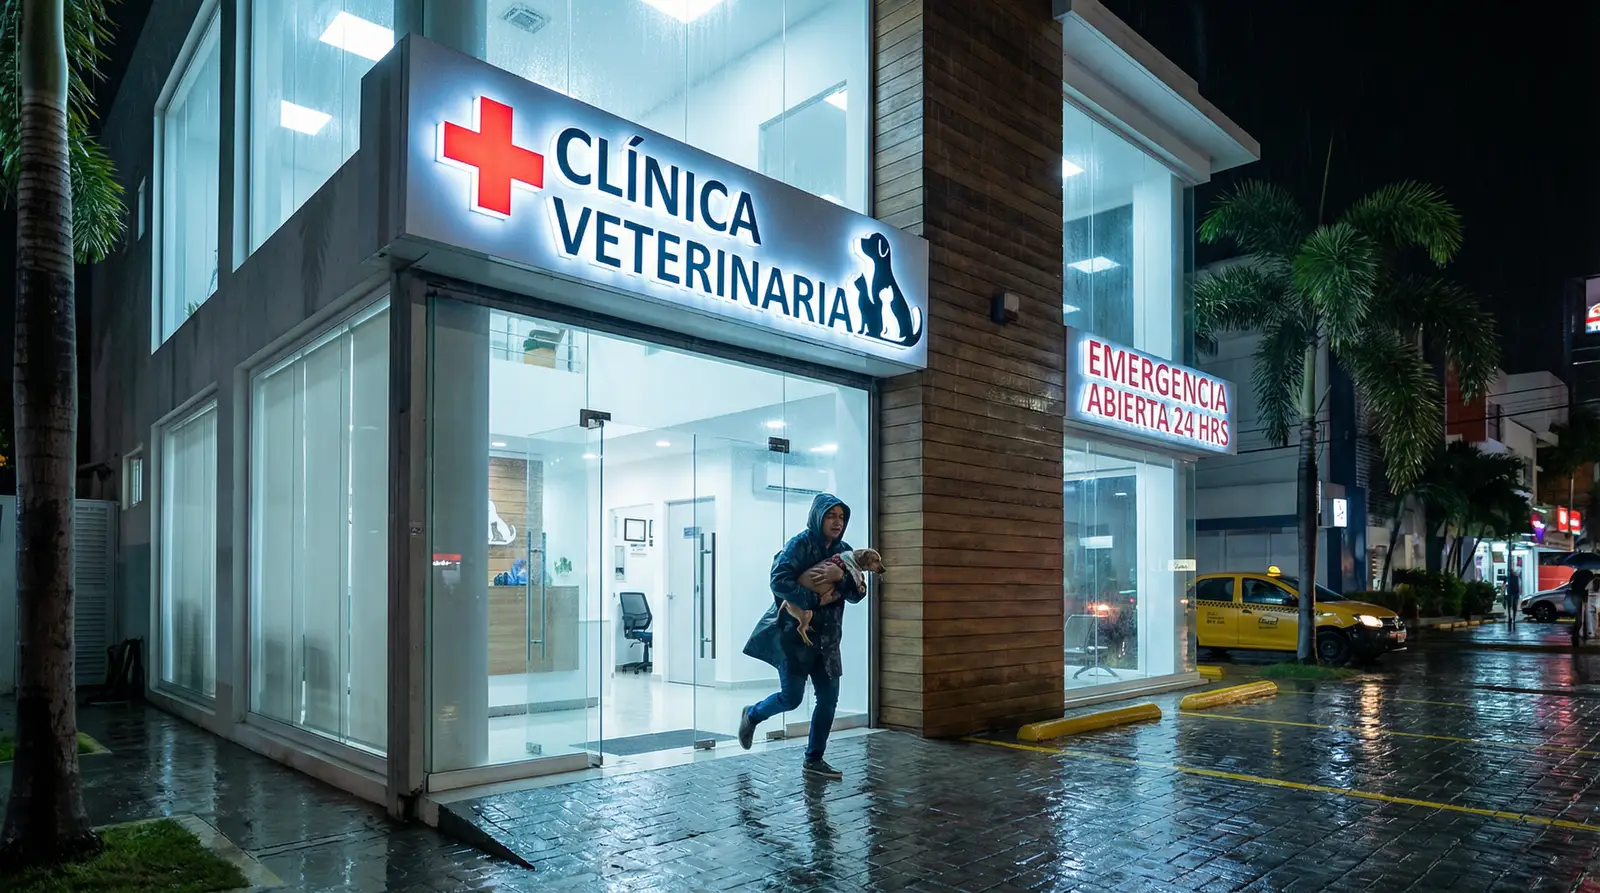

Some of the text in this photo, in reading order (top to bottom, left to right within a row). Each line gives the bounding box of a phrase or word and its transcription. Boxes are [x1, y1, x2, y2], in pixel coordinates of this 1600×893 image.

[555, 127, 762, 246] CLÍNICA
[553, 196, 853, 334] VETERINARIA
[1087, 383, 1229, 446] ABIERTA 24 HRS
[1089, 340, 1228, 414] EMERGENCIA
